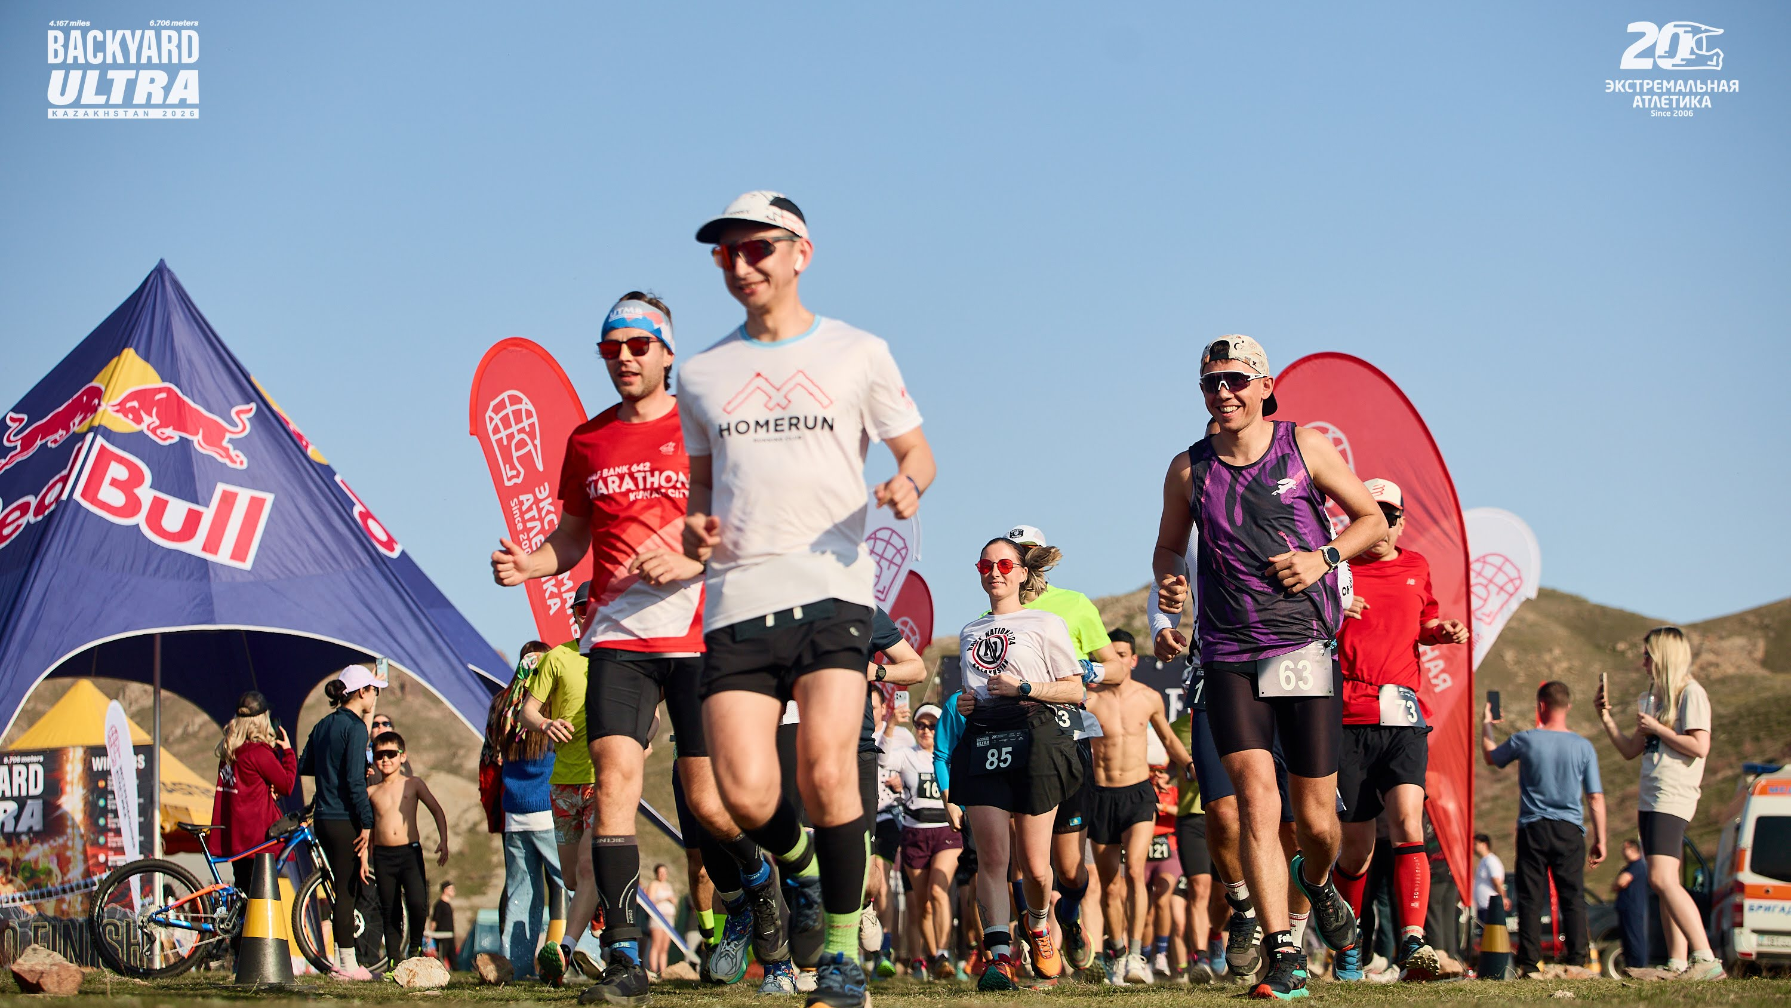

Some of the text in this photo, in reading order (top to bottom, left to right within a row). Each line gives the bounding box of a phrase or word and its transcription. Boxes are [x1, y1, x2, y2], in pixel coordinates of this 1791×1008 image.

[717, 415, 835, 438] HOMERUN
[602, 465, 630, 478] BANK
[631, 462, 652, 473] 642
[0, 432, 94, 549] ed
[74, 435, 275, 570] Bull
[510, 498, 532, 556] Since 200
[1278, 659, 1314, 691] 63
[1054, 709, 1071, 728] 3
[1394, 699, 1418, 724] 73
[985, 746, 1013, 770] 85
[0, 763, 44, 798] ARD
[0, 799, 44, 833] RA
[1149, 843, 1169, 858] 121
